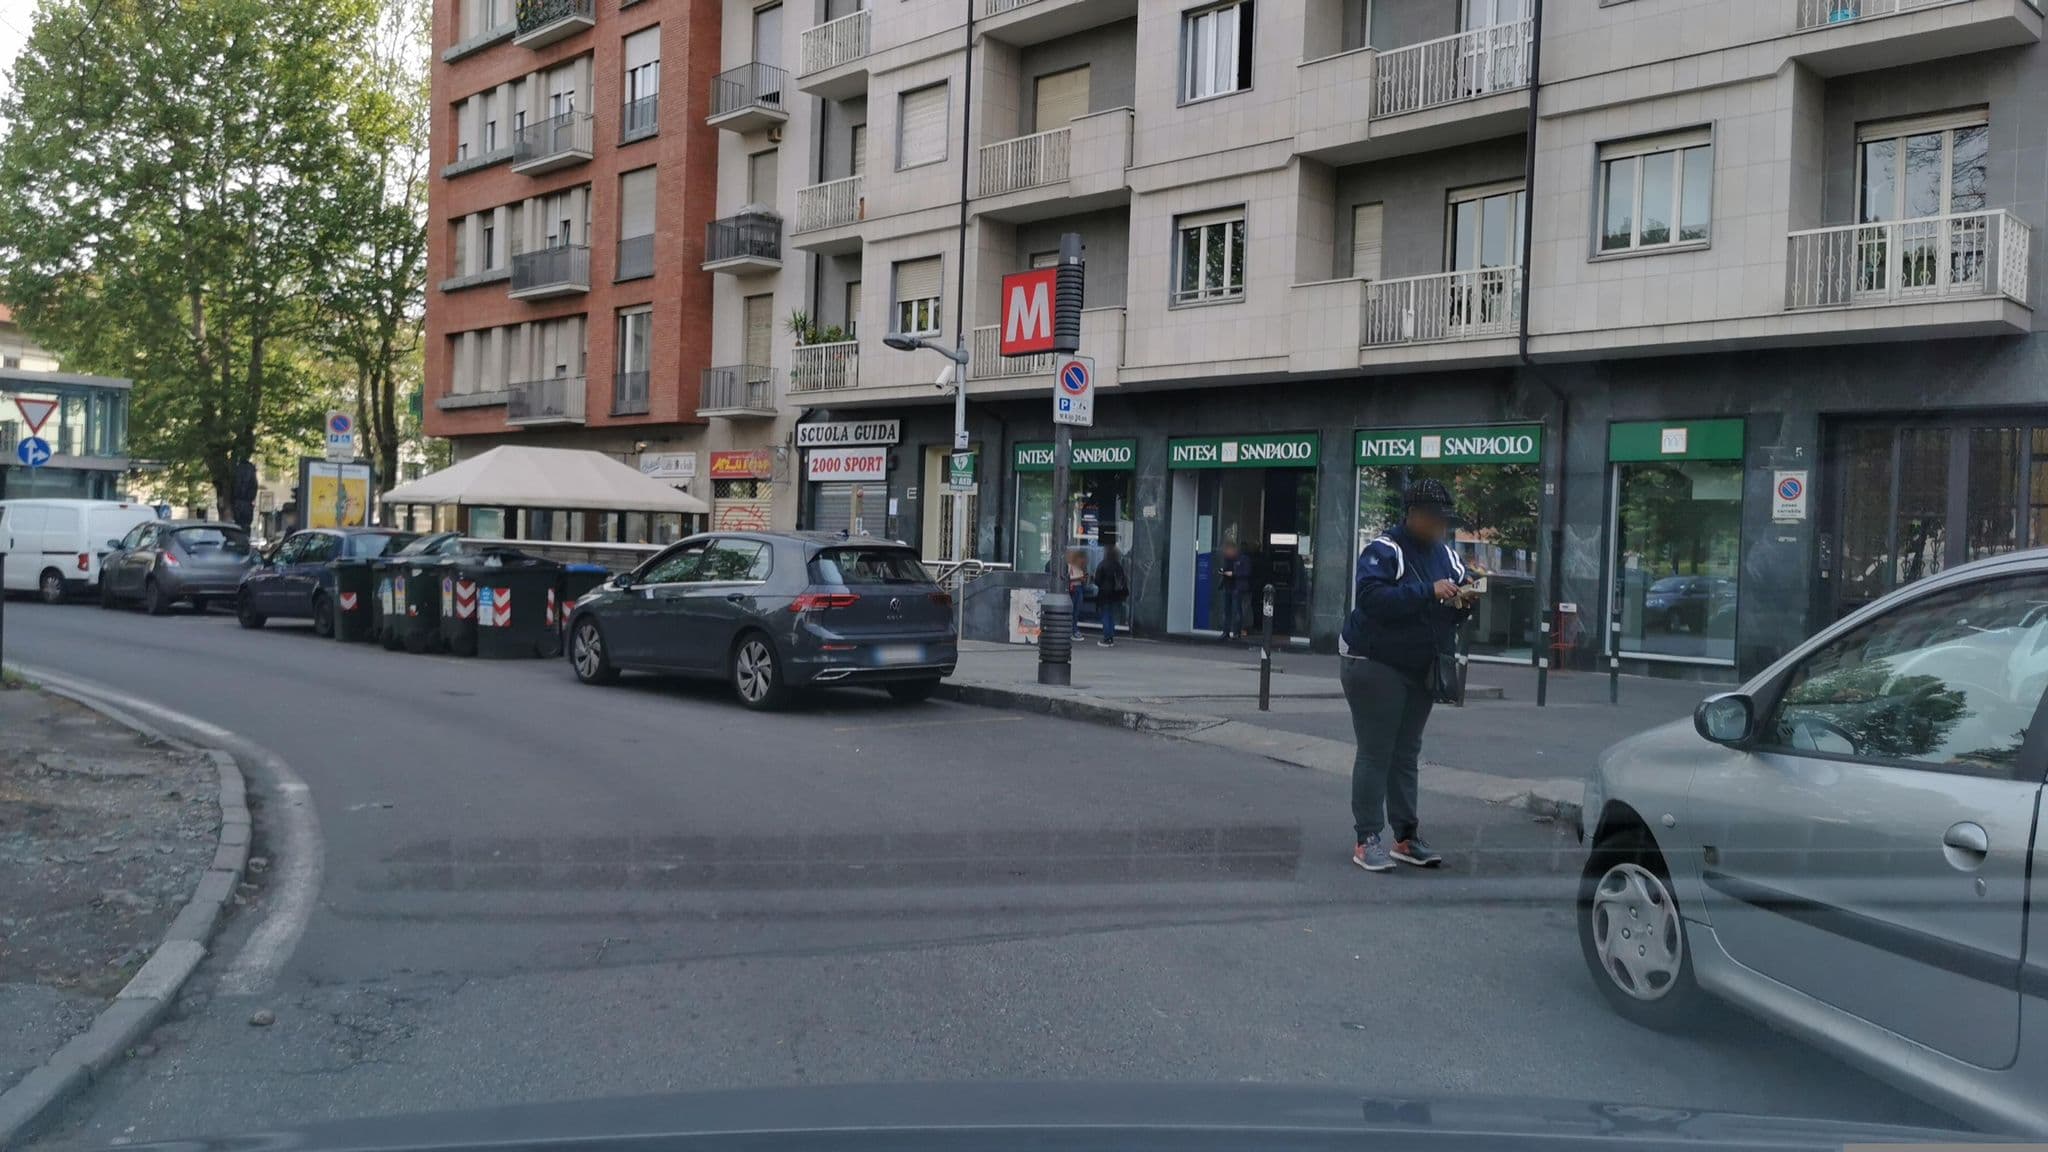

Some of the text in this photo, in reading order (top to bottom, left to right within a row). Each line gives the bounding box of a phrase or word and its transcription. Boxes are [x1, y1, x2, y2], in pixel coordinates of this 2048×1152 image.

[1005, 282, 1050, 342] M
[1061, 399, 1069, 410] P
[800, 424, 896, 442] SCUOLA GUIDA
[1173, 442, 1312, 461] INTESA SANPAOLO
[1361, 436, 1533, 456] INTESA SANPAOLO
[812, 456, 883, 472] 2000 SPORT
[1018, 447, 1131, 464] INTESA SANPAOLO
